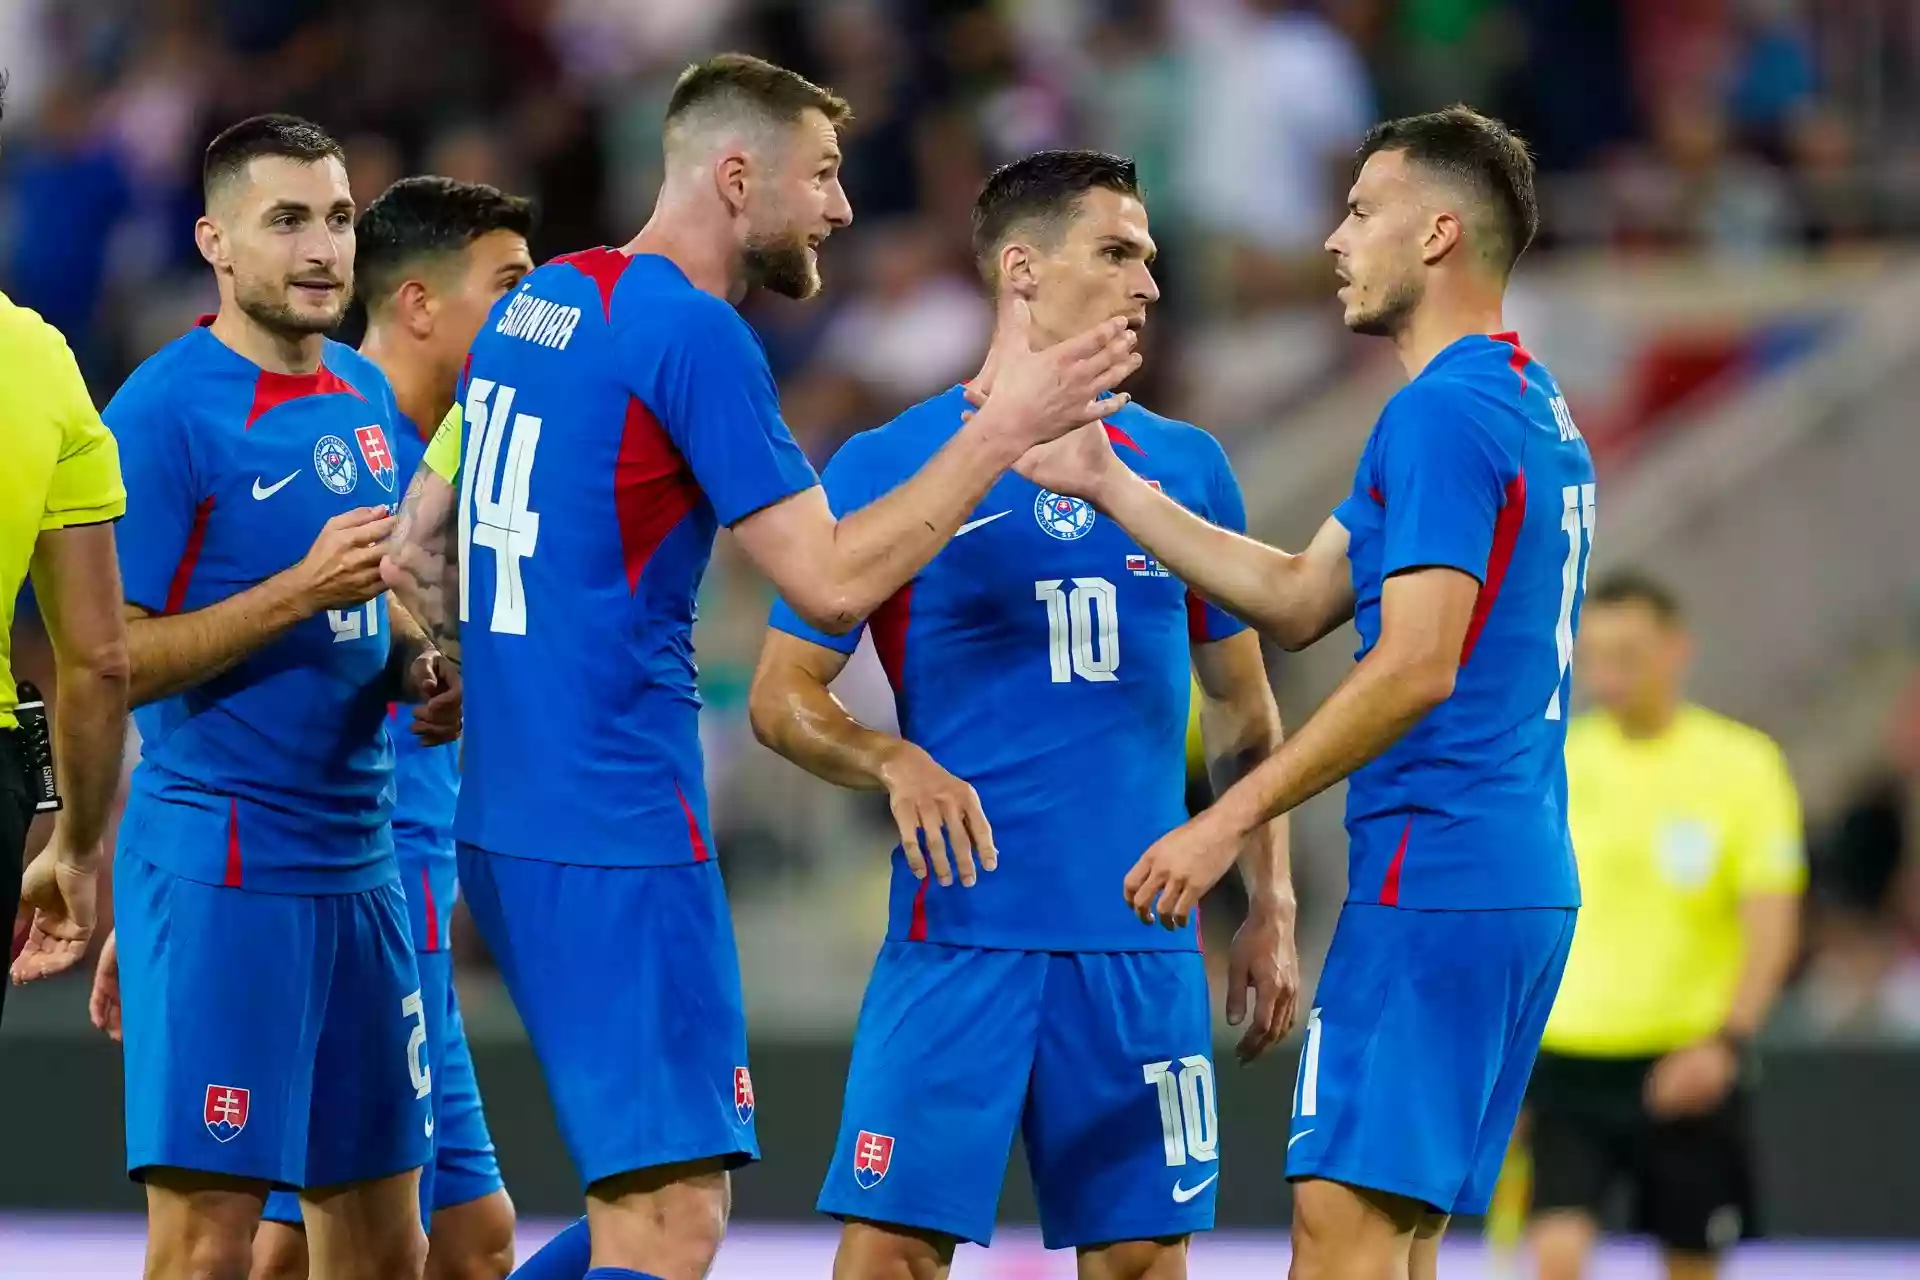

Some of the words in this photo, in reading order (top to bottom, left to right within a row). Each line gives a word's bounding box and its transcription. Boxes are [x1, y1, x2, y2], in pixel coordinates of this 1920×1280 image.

[457, 377, 543, 636] 14
[1034, 576, 1120, 683] 10
[1142, 1054, 1219, 1167] 10
